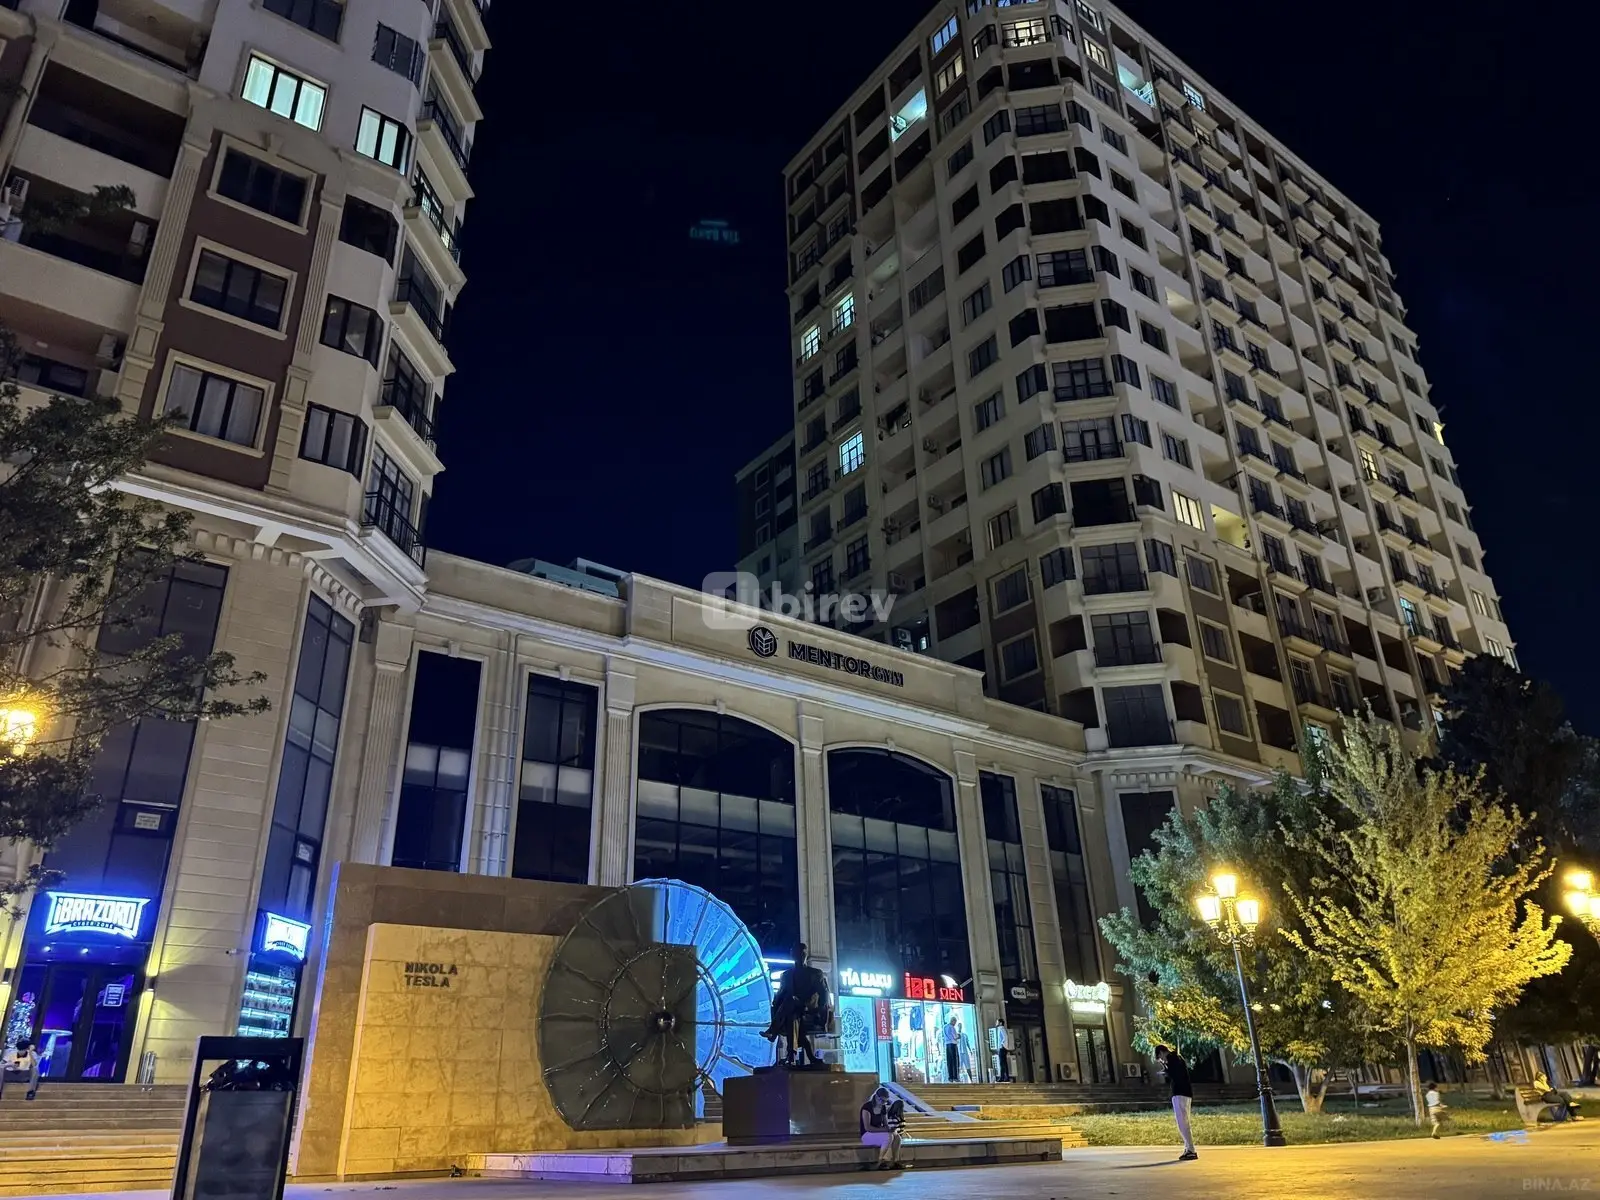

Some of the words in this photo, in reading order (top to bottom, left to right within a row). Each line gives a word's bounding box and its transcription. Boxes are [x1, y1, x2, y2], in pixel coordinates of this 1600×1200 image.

[788, 641, 872, 678] MENTOR
[872, 666, 904, 687] GYM
[405, 962, 458, 975] NIKOLA
[404, 975, 450, 987] TESLA
